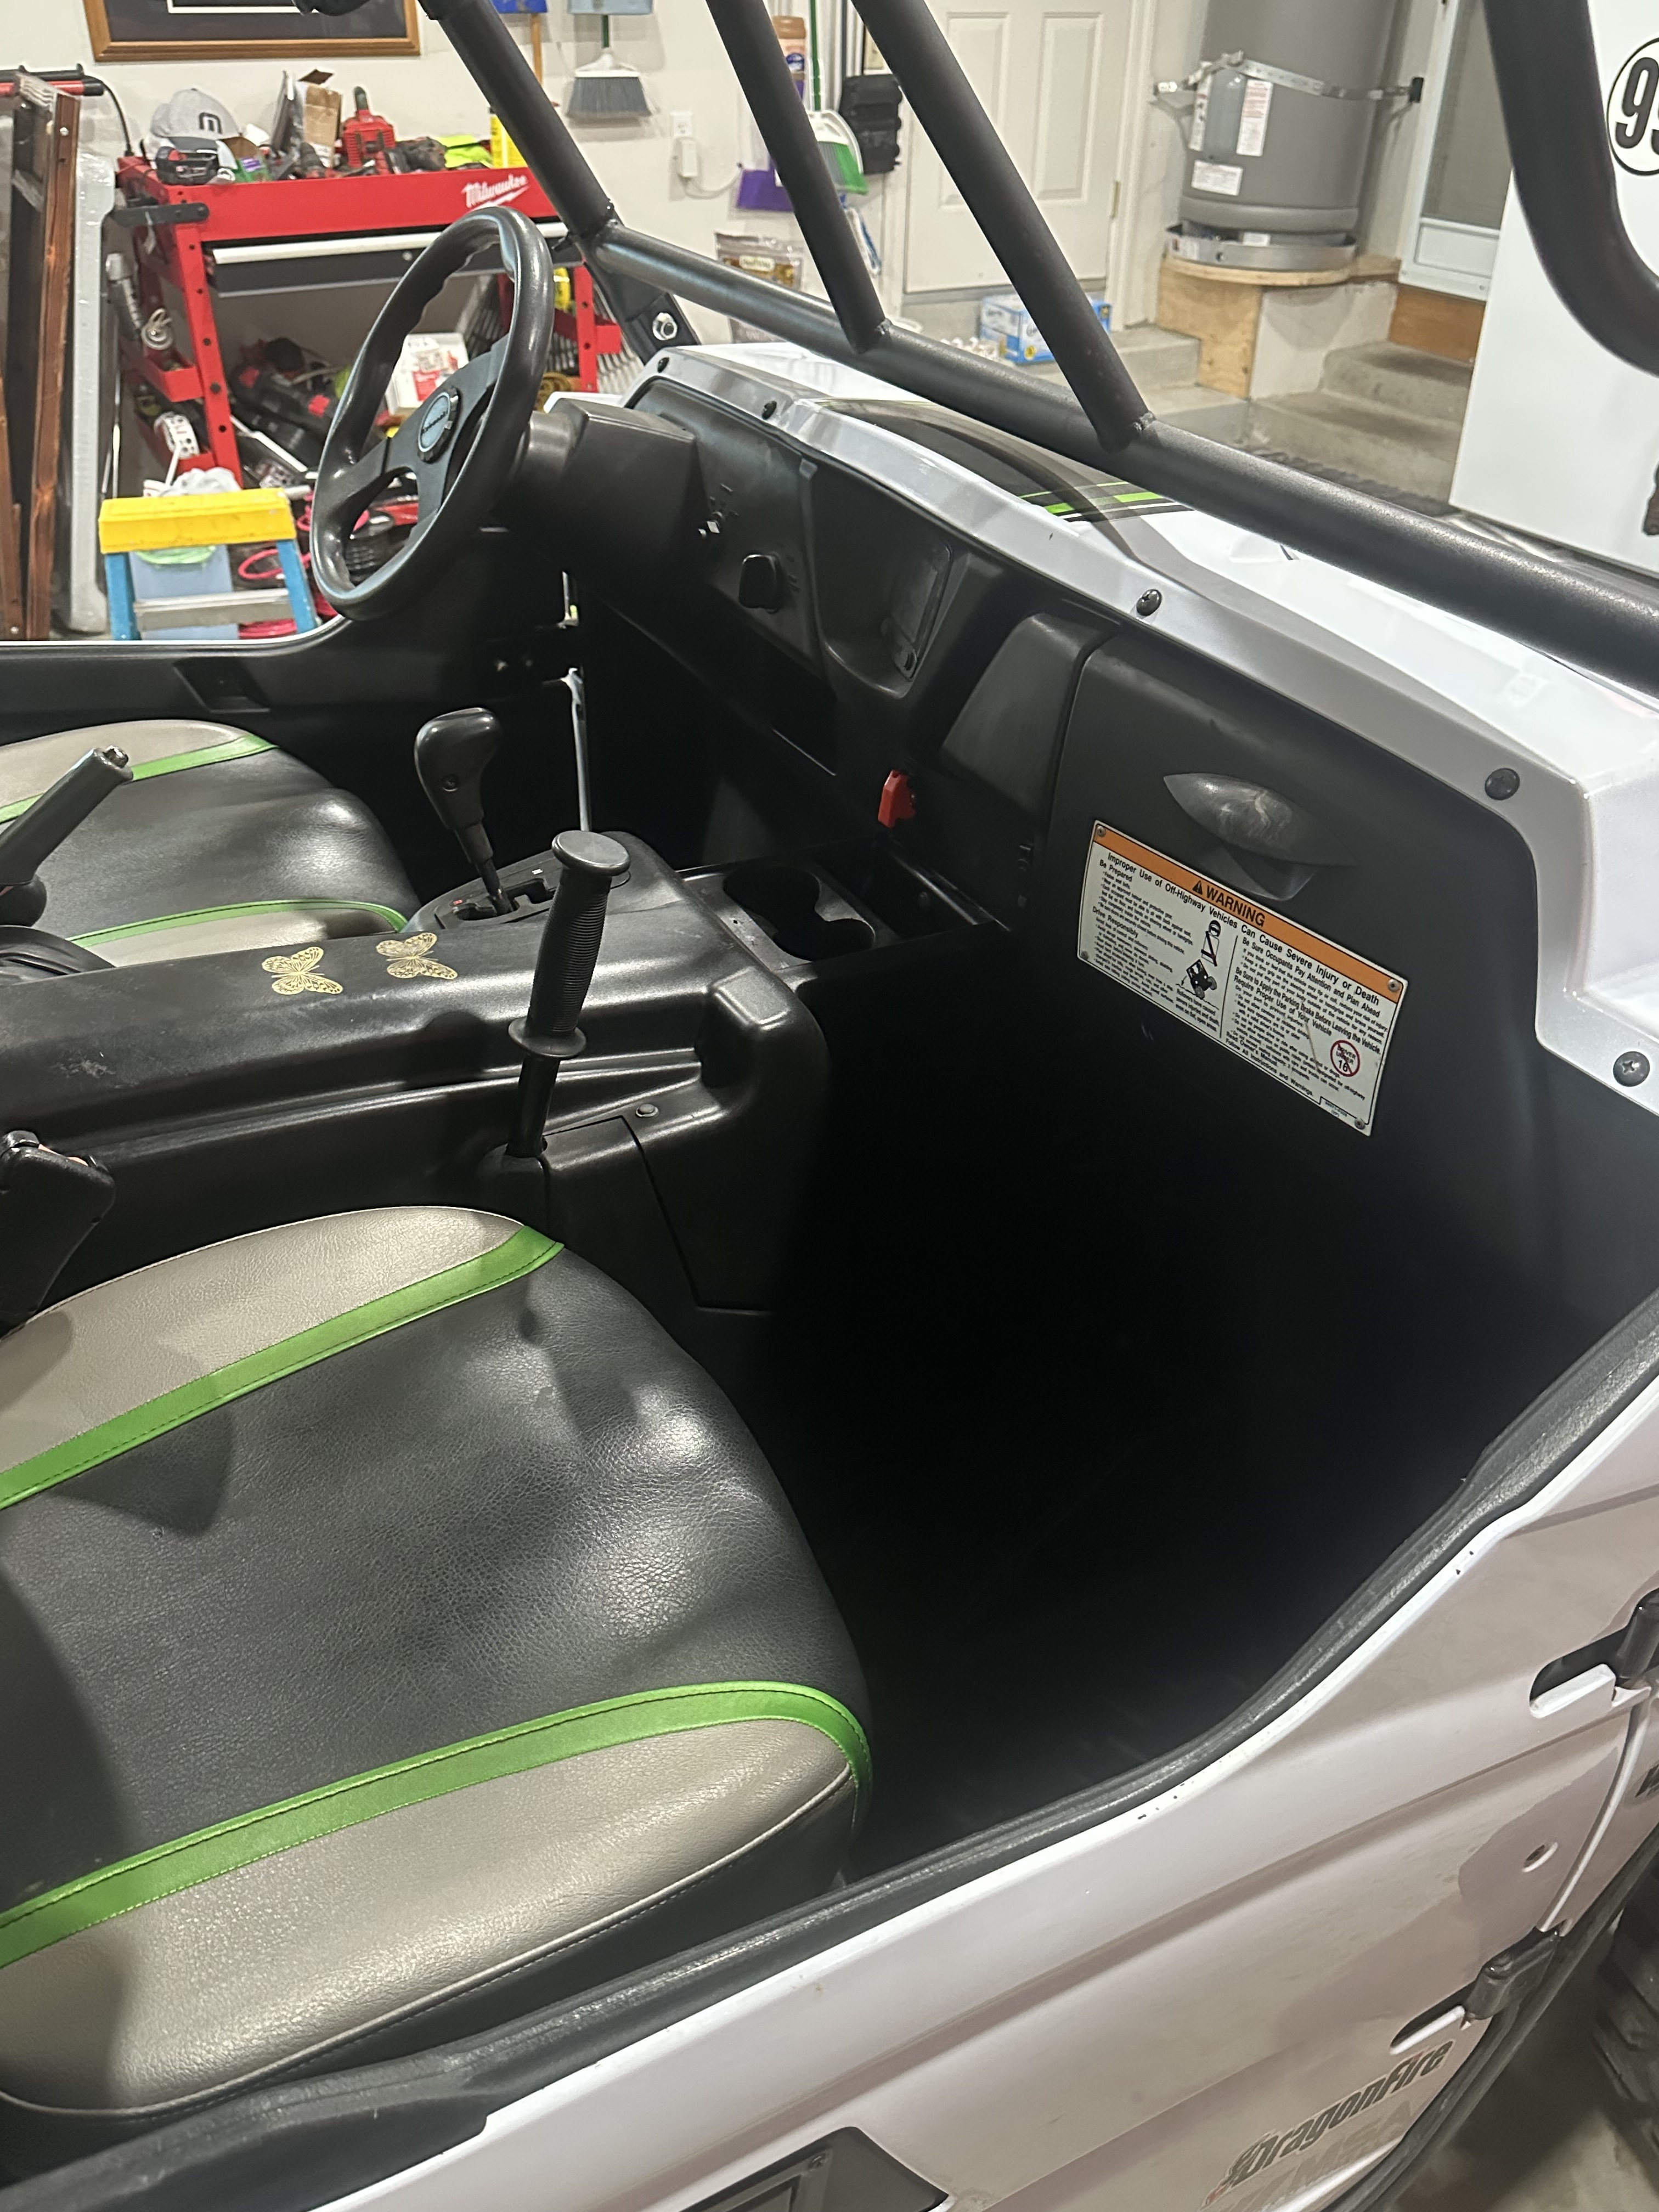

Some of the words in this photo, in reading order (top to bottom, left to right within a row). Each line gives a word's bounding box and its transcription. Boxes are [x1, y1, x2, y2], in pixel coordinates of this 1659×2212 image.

[461, 173, 528, 208] Milwaukee
[1099, 859, 1107, 868] Be
[1109, 864, 1132, 882] Prepared
[1092, 906, 1105, 918] Drive
[1107, 915, 1138, 939] Responsibly
[1206, 885, 1265, 927] WARNING
[1107, 852, 1137, 873] Improper
[1139, 868, 1152, 882] Use
[1165, 883, 1206, 912] Off-Highway
[1209, 906, 1238, 928] Vehicles
[1241, 924, 1256, 938] Can
[1259, 934, 1283, 953] Cause
[1286, 948, 1312, 969] Severe
[1316, 964, 1339, 985] Injury
[1342, 981, 1352, 990] or
[1354, 985, 1379, 1006] Death
[1242, 936, 1250, 946] Be
[1251, 941, 1263, 954] Sure
[1266, 950, 1293, 970] Occupants
[1295, 966, 1305, 978] Pay
[1306, 973, 1331, 991] Attention
[1333, 988, 1345, 998] and
[1346, 994, 1359, 1007] Plan
[1361, 1002, 1380, 1018] Ahead
[1234, 974, 1254, 991] Require
[1256, 987, 1274, 1002] Proper
[1276, 998, 1286, 1010] Use
[1297, 1011, 1310, 1023] Your
[1312, 1019, 1332, 1036] Vehicle
[1235, 966, 1242, 976] Be
[1242, 970, 1254, 982] Sure
[1254, 977, 1259, 985] to
[1259, 980, 1273, 995] Apply
[1273, 988, 1281, 998] the
[1281, 992, 1300, 1010] Parking
[1300, 1002, 1314, 1017] Brake
[1314, 1011, 1331, 1026] Before
[1331, 1021, 1352, 1040] Leaving
[1352, 1033, 1361, 1043] the
[1362, 1037, 1381, 1055] Vehicle.
[1226, 1031, 1238, 1042] Read
[1240, 1040, 1259, 1054] Owner's
[1336, 1051, 1354, 1065] UNDER
[1337, 1046, 1356, 1060] DRIVER
[1226, 1038, 1240, 1051] Follow
[1250, 1053, 1277, 1074] Instructions
[1279, 1072, 1288, 1080] and
[1290, 1078, 1313, 1096] Warnings.
[1338, 1060, 1348, 1072] 16
